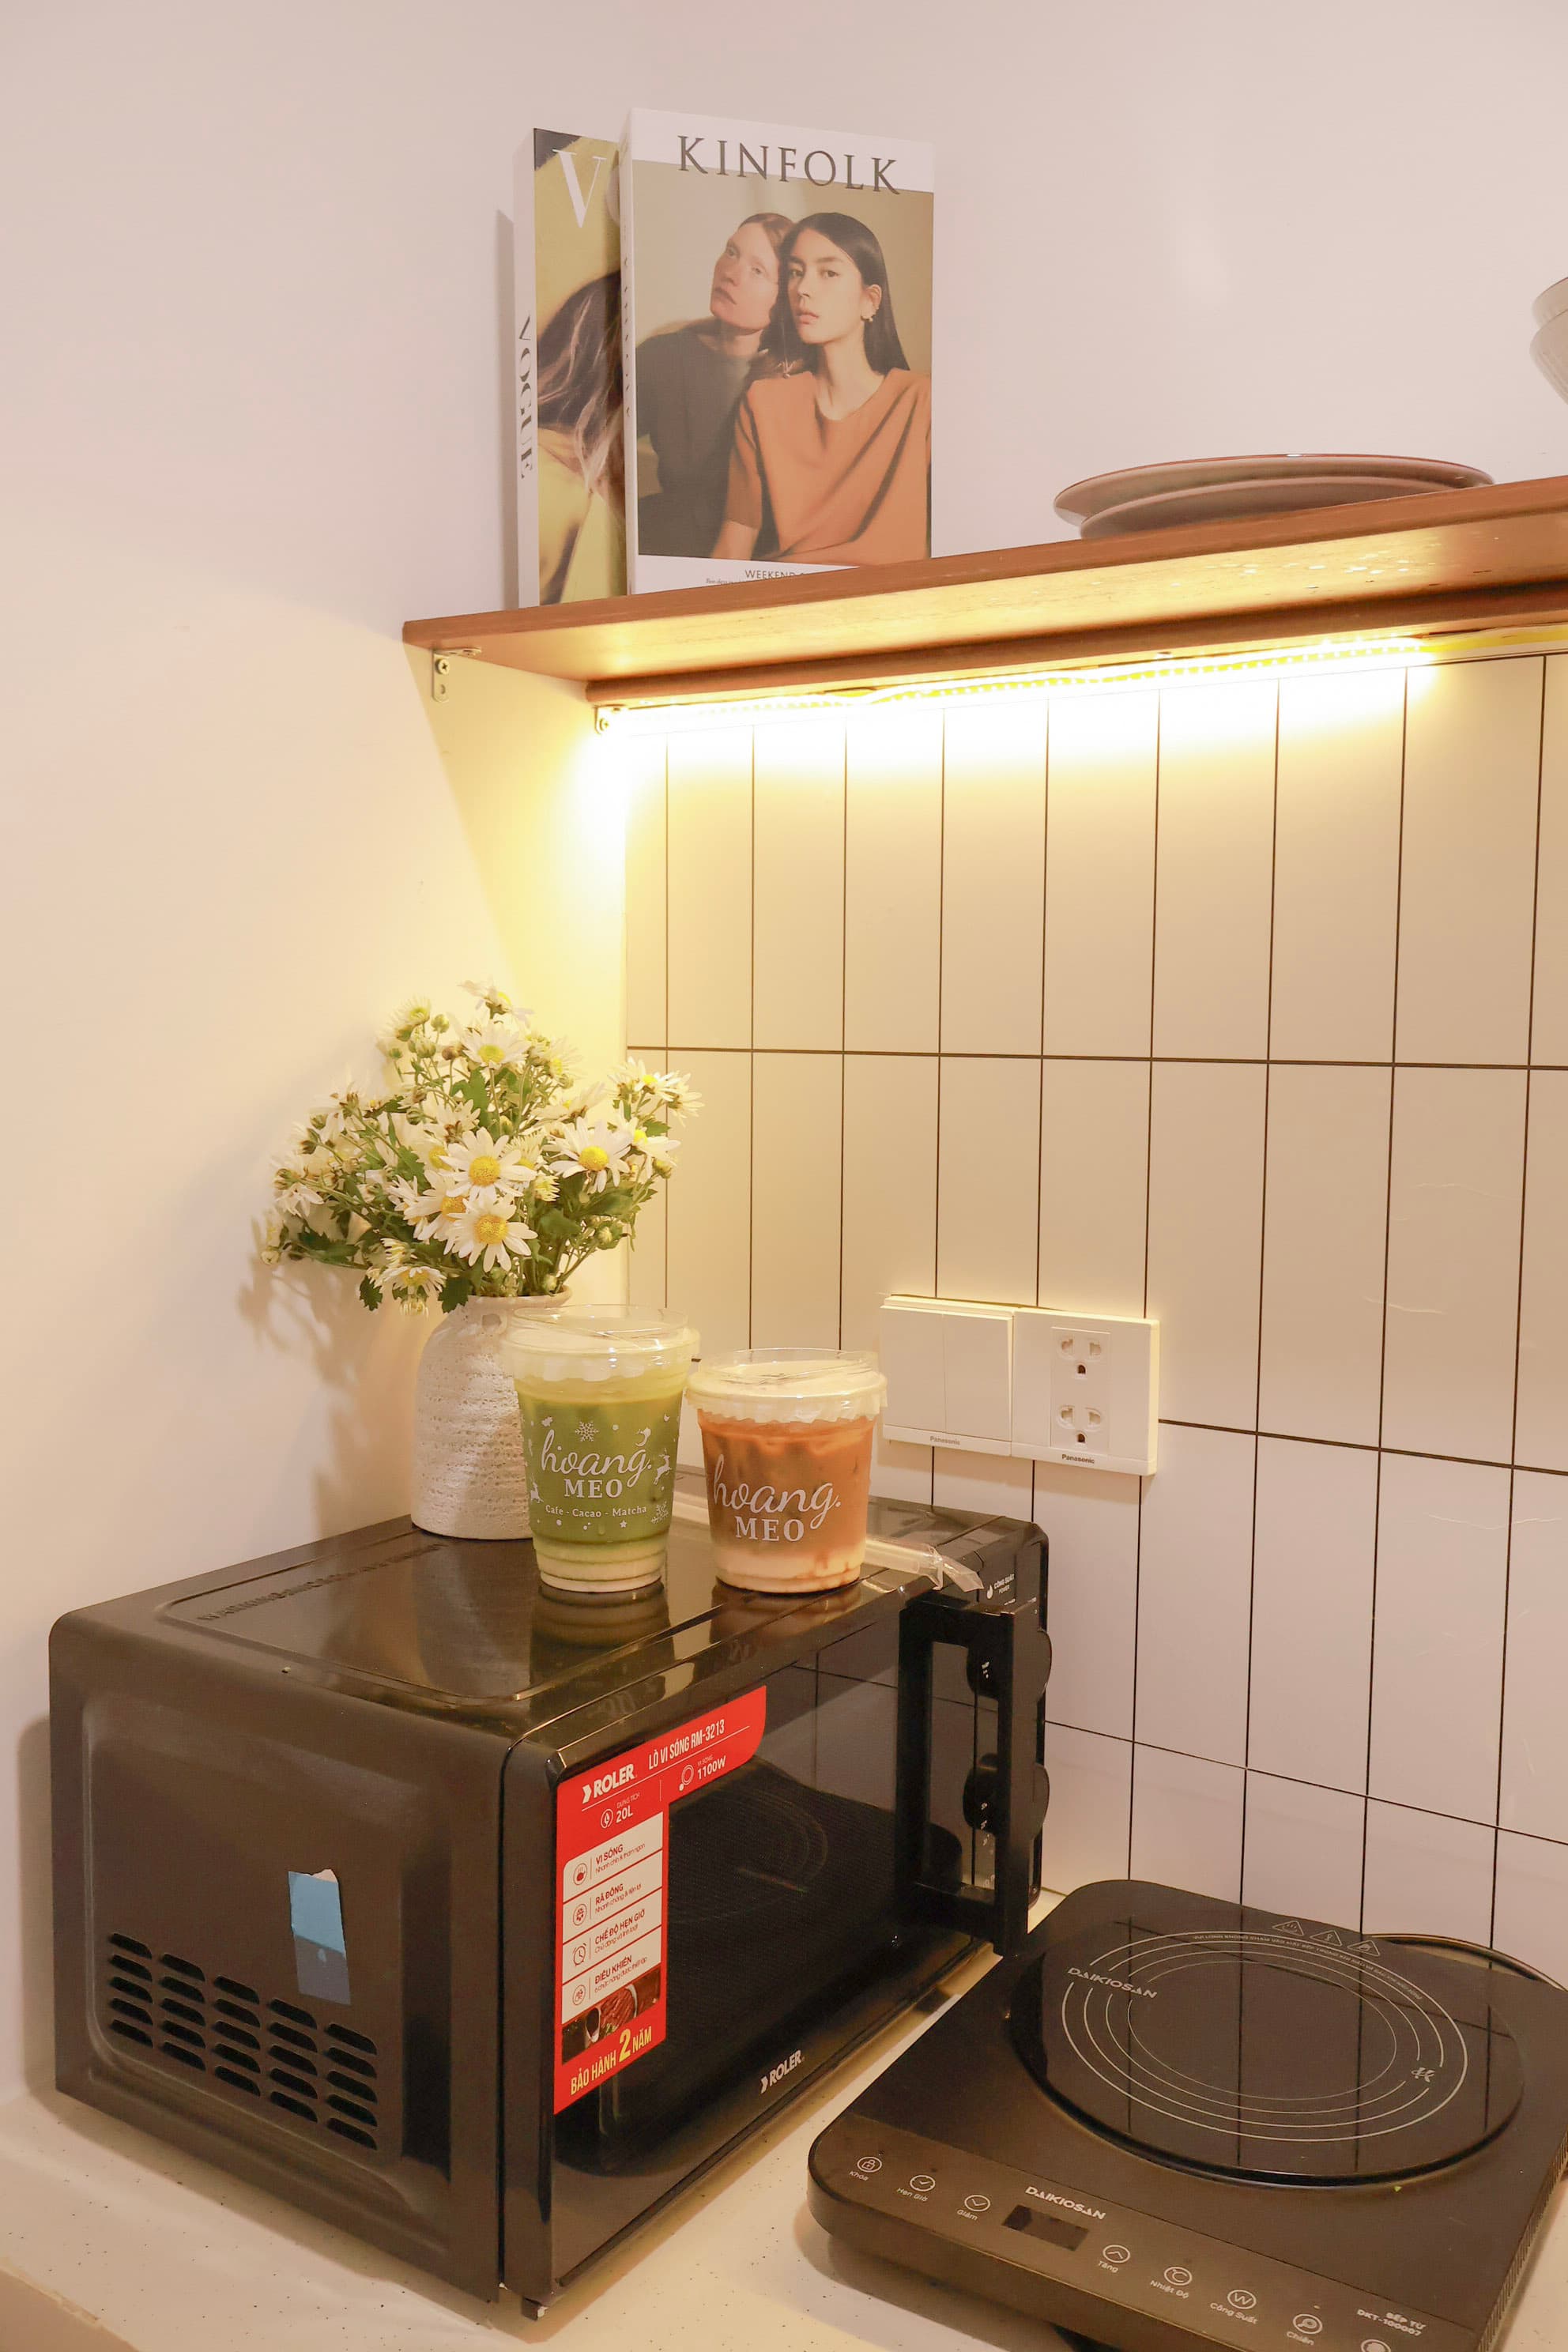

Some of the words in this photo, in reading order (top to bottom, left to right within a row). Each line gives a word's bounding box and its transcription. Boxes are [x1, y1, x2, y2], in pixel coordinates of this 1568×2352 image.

[677, 135, 900, 195] KINFOLK
[552, 148, 620, 228] V
[518, 315, 533, 479] VOGUE
[930, 1435, 960, 1446] Panasonic
[1061, 1453, 1095, 1464] Panasonic
[564, 1479, 623, 1498] MEO
[545, 1504, 564, 1515] Cafe
[571, 1508, 602, 1517] Cacao
[612, 1506, 646, 1517] Matcha
[735, 1516, 804, 1541] MEO
[648, 1749, 659, 1770] LÒ
[660, 1744, 668, 1765] VI
[669, 1737, 690, 1759] SÓNG
[691, 1719, 726, 1749] RM-3213
[594, 1763, 635, 1799] ROLER
[697, 1755, 727, 1780] 1100W
[616, 1805, 634, 1823] 20L
[595, 1855, 603, 1865] VI
[603, 1844, 624, 1861] SÓNG
[605, 1883, 624, 1900] ĐÔNG
[594, 1929, 609, 1945] CHẾ
[609, 1924, 619, 1937] ĐỘ
[620, 1916, 633, 1930] HẸN
[594, 1969, 611, 1984] ĐIỀU
[612, 1954, 632, 1974] KHIỂN
[1067, 1967, 1157, 1999] DAIKIOSAN
[571, 2067, 590, 2095] BẢO
[591, 2049, 616, 2081] HÀNH
[619, 2028, 631, 2063] 2
[632, 2026, 652, 2053] NĂM
[769, 2049, 802, 2087] ROLER
[1025, 2186, 1106, 2219] DAIKIOSAN
[1209, 2301, 1234, 2316] Công
